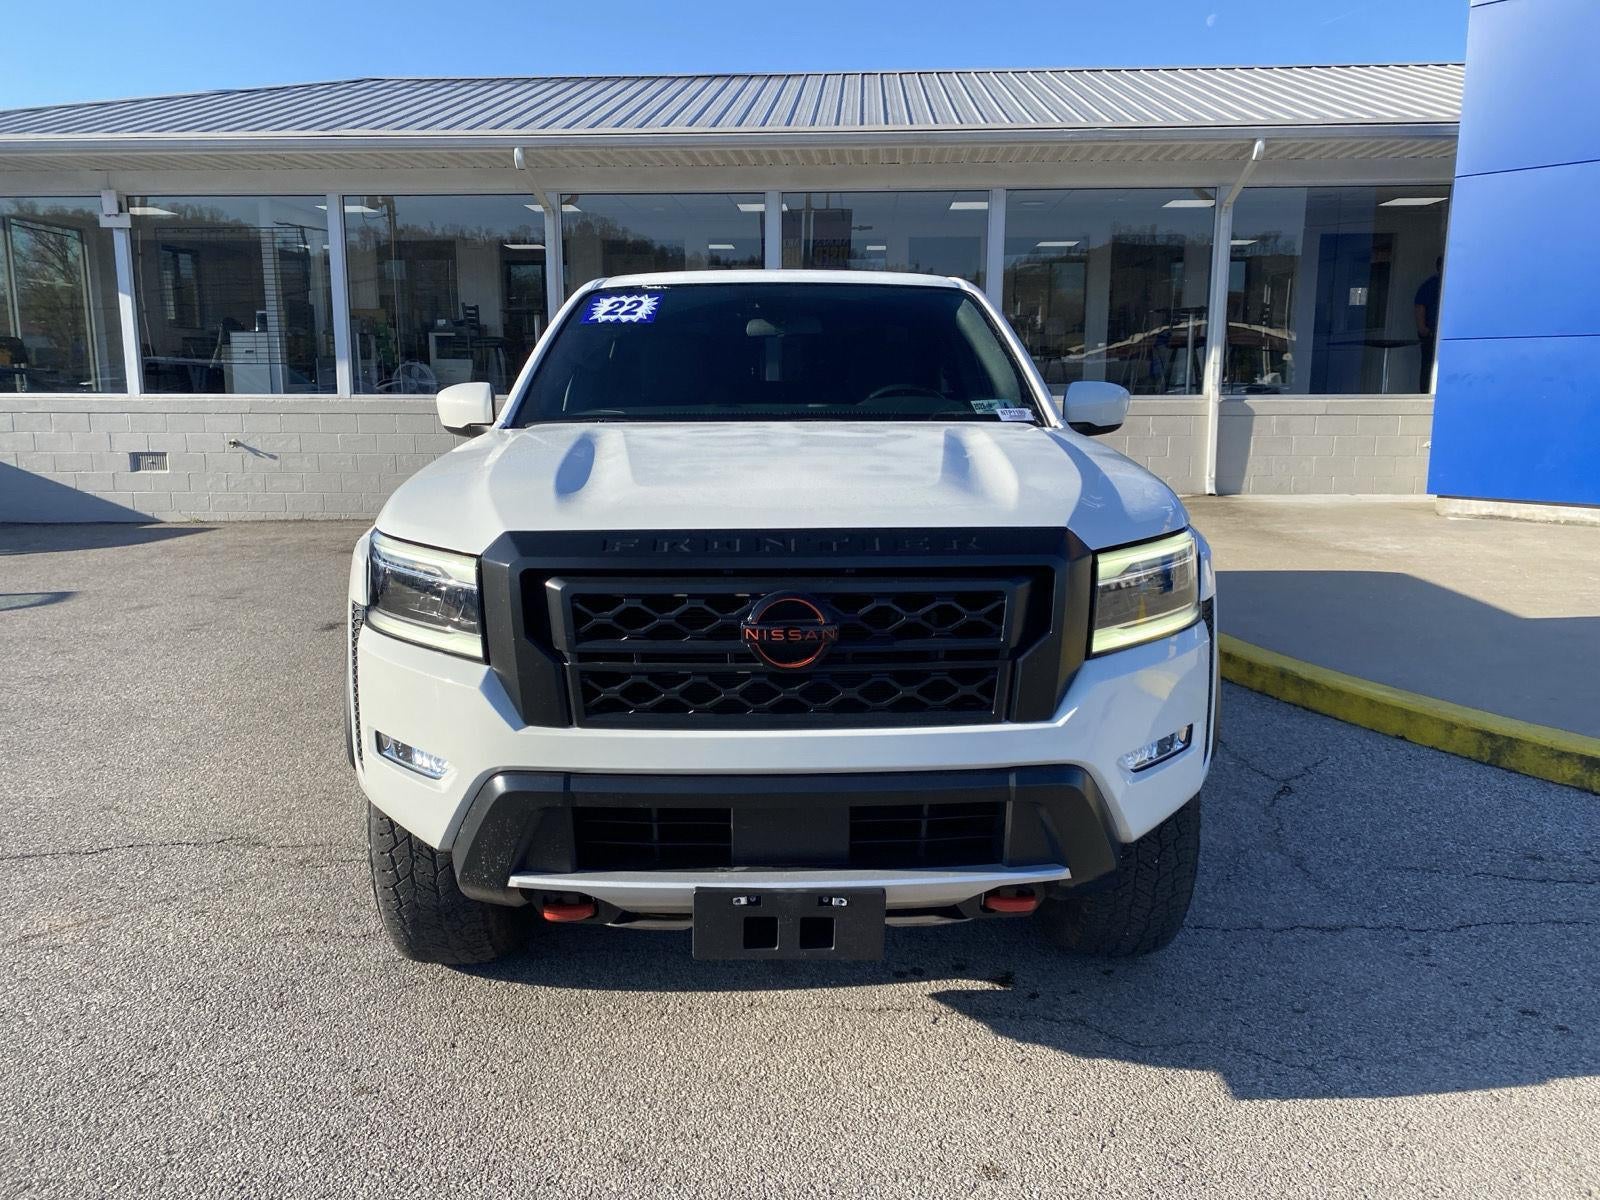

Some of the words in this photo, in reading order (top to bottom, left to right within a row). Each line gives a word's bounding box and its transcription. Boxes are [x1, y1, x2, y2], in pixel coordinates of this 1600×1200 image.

[602, 300, 643, 316] 22
[602, 536, 983, 553] FRONTIER
[744, 628, 836, 641] NISSAN
